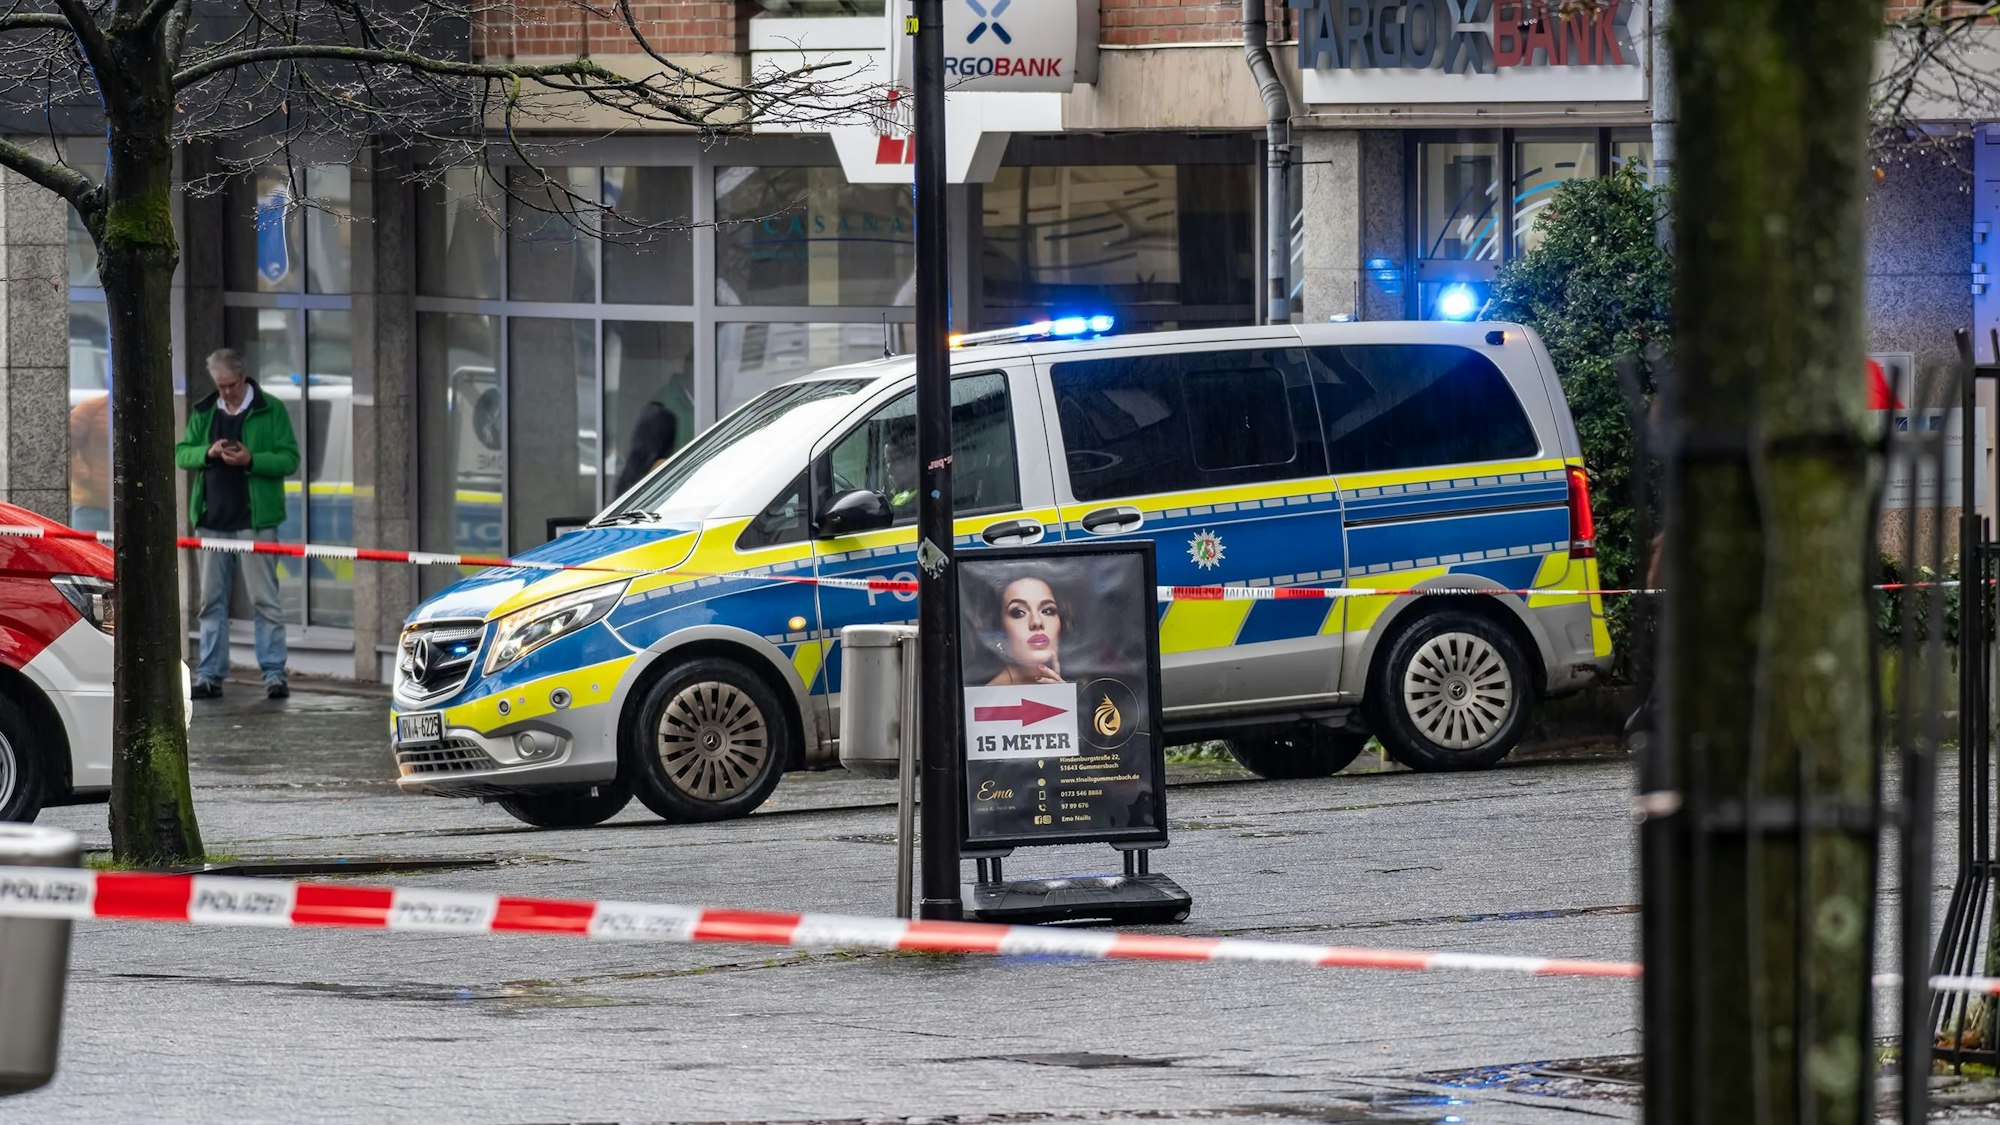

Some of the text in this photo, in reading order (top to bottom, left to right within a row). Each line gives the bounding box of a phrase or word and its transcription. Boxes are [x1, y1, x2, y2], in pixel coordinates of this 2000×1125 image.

[944, 57, 1062, 77] RGOBANK
[976, 732, 1071, 752] 15 METER
[1060, 754, 1111, 763] Hindenburgstraße
[1078, 762, 1119, 770] Gummersbach
[977, 780, 1015, 801] Ema
[1076, 789, 1088, 797] 546
